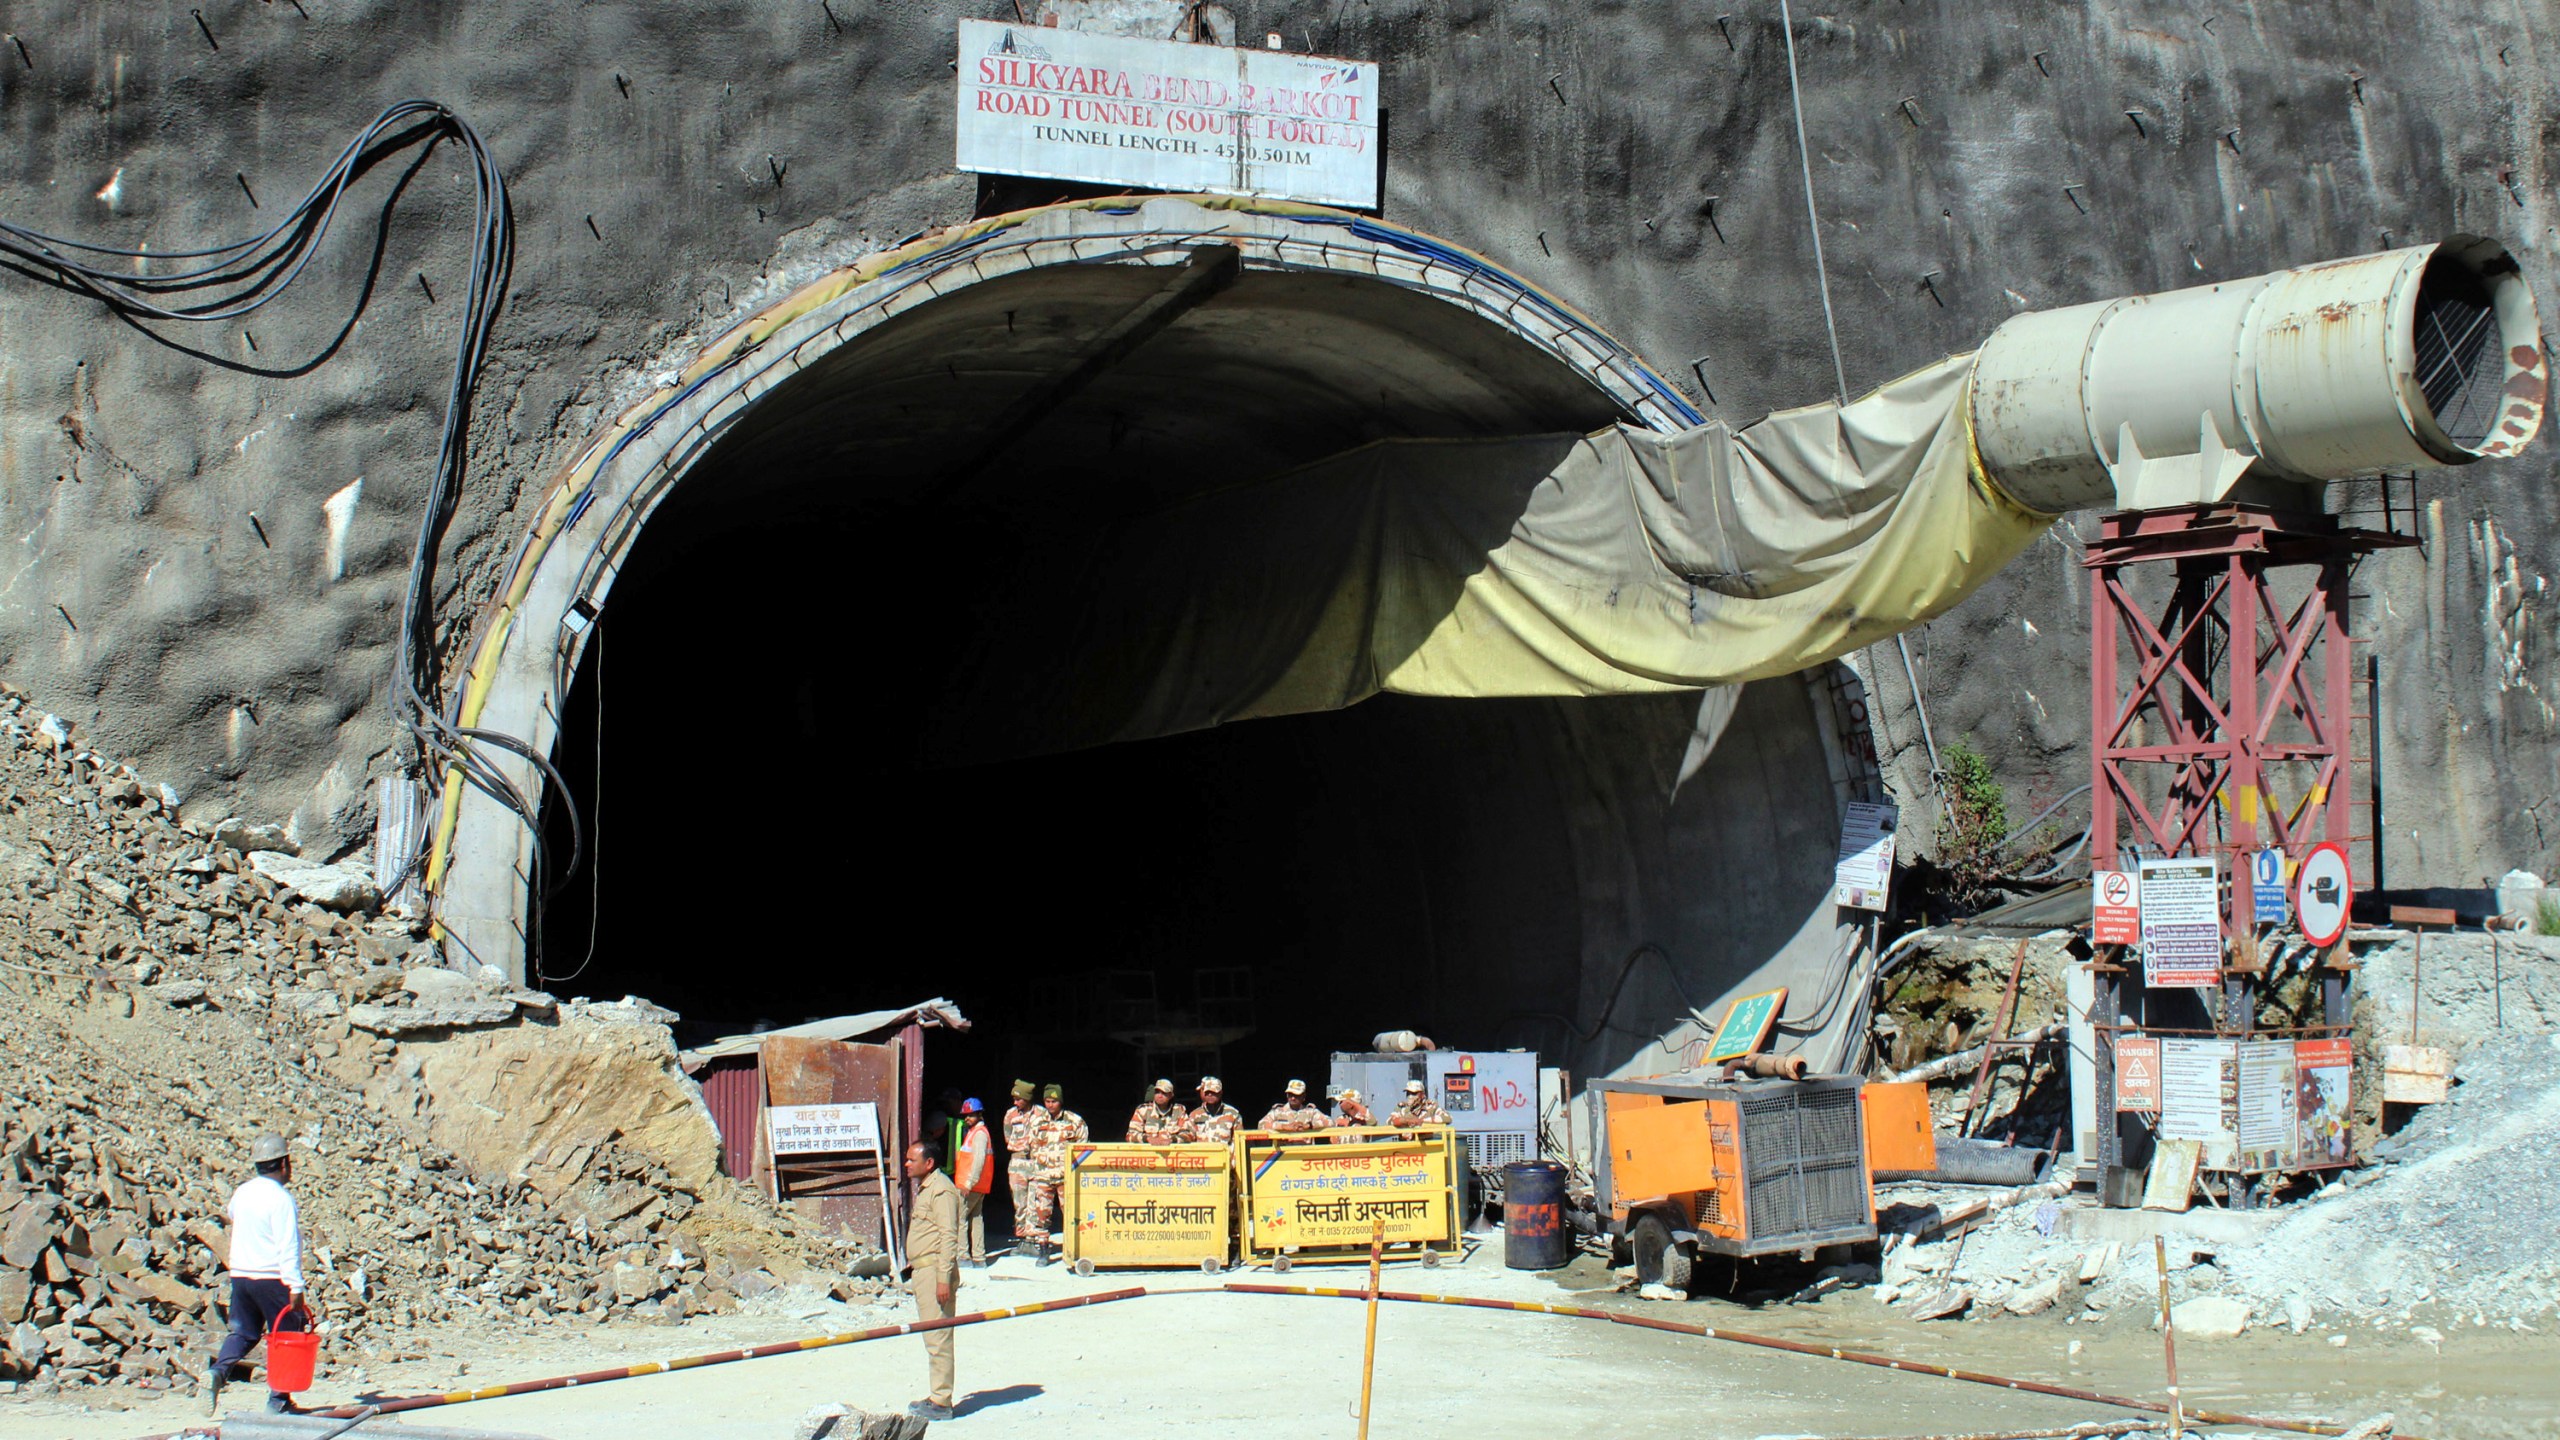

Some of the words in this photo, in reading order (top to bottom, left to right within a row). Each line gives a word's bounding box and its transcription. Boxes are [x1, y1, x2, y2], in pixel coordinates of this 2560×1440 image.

[979, 57, 1134, 98] SILKYARA
[976, 89, 1051, 117] ROAD
[1058, 98, 1158, 128] TUNNEL
[1167, 108, 1260, 138] (SOUTH
[1267, 119, 1365, 153] PORTAL)
[1033, 125, 1112, 147] TUNNEL
[1119, 134, 1197, 154] LENGTH
[2119, 1048, 2155, 1057] DANGER
[2124, 1078, 2151, 1088] खतरा
[794, 1109, 818, 1122] याद
[793, 1124, 811, 1137] नियम
[797, 1138, 812, 1149] कभी
[1100, 1156, 1160, 1170] उत्तराखण्ड
[1165, 1152, 1209, 1173] पुलिस
[1300, 1156, 1375, 1172] उत्तराखण्ड
[1379, 1151, 1427, 1173] पुलिस
[1080, 1173, 1090, 1188] दो
[1092, 1177, 1108, 1188] गज
[1110, 1173, 1123, 1187] की
[1147, 1176, 1174, 1188] मास्क
[1280, 1174, 1292, 1191] दो
[1293, 1179, 1314, 1191] गज
[1316, 1175, 1330, 1189] की
[1351, 1176, 1378, 1188] मास्क
[1104, 1200, 1157, 1225] सिनर्जी
[1157, 1205, 1216, 1225] अस्पताल
[1295, 1197, 1351, 1223] सिनर्जी
[1354, 1199, 1430, 1221] अस्पताल
